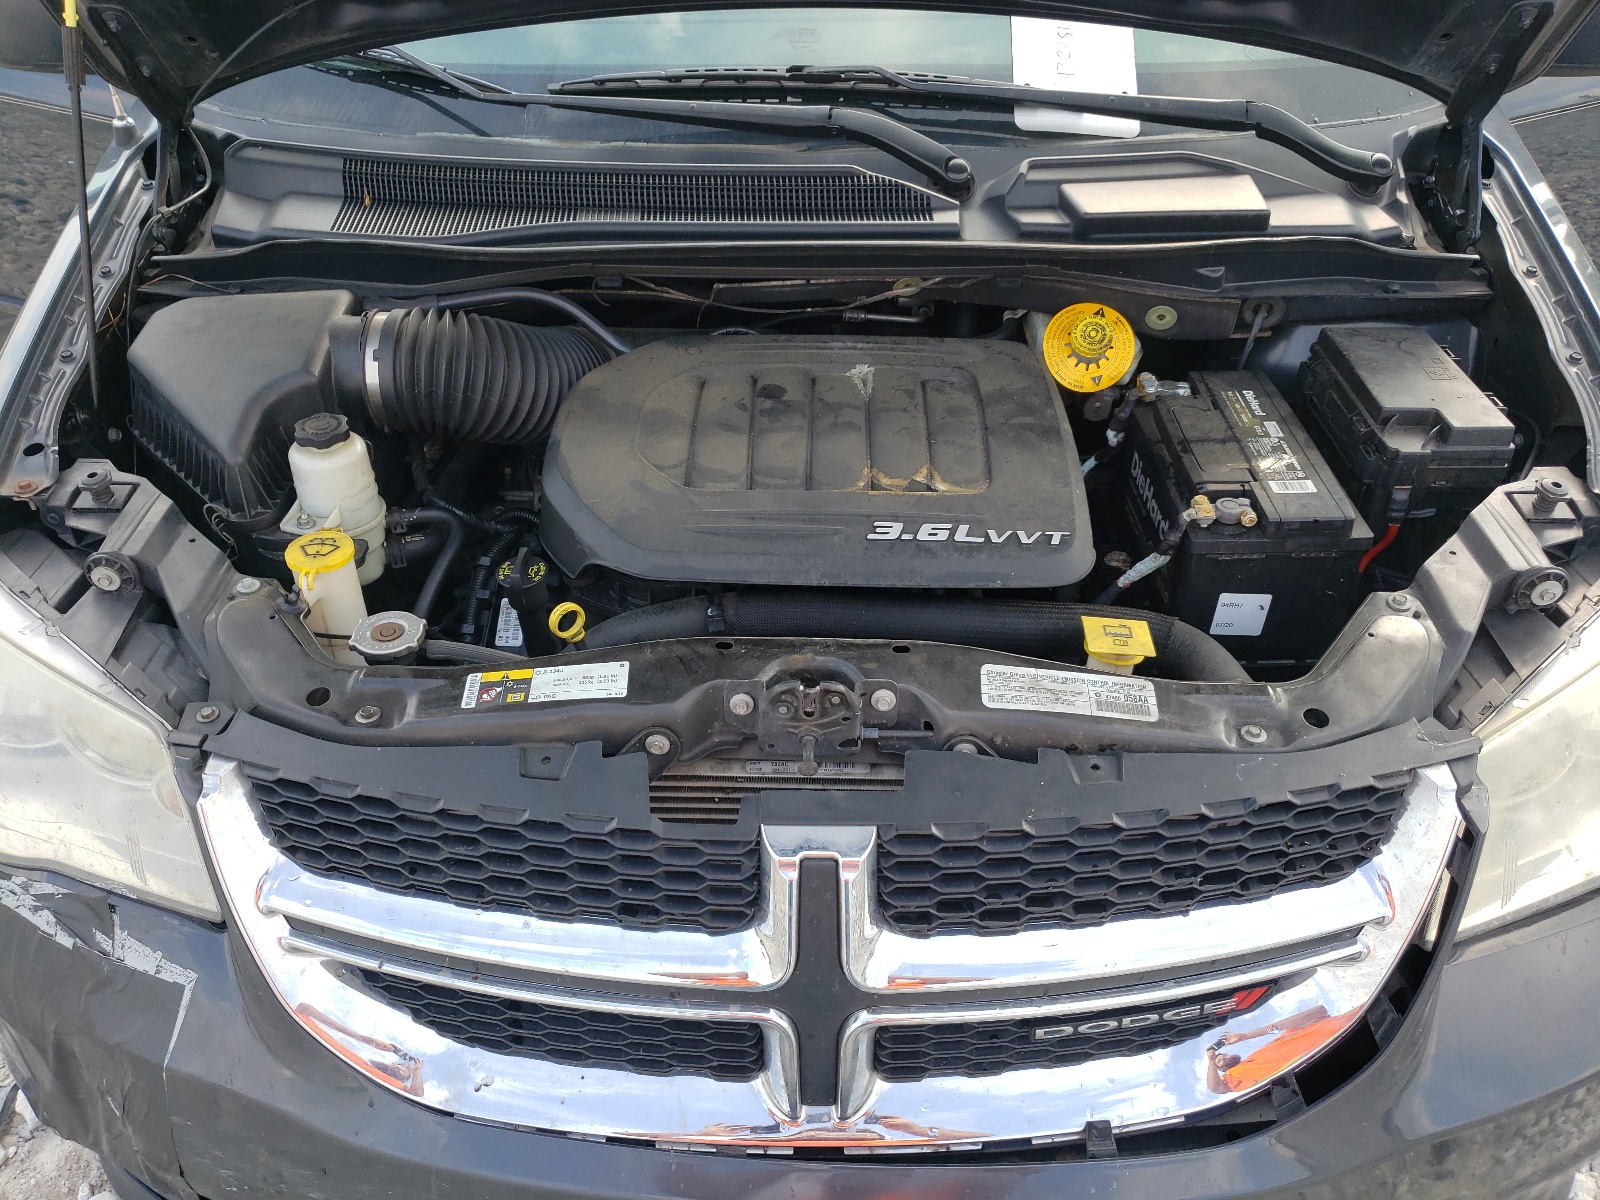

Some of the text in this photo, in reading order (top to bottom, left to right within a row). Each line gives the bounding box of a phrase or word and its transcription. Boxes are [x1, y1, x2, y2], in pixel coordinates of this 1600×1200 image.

[1242, 389, 1266, 416] DieHard
[1130, 450, 1170, 538] DieHard
[1033, 997, 1239, 1040] DODGE
